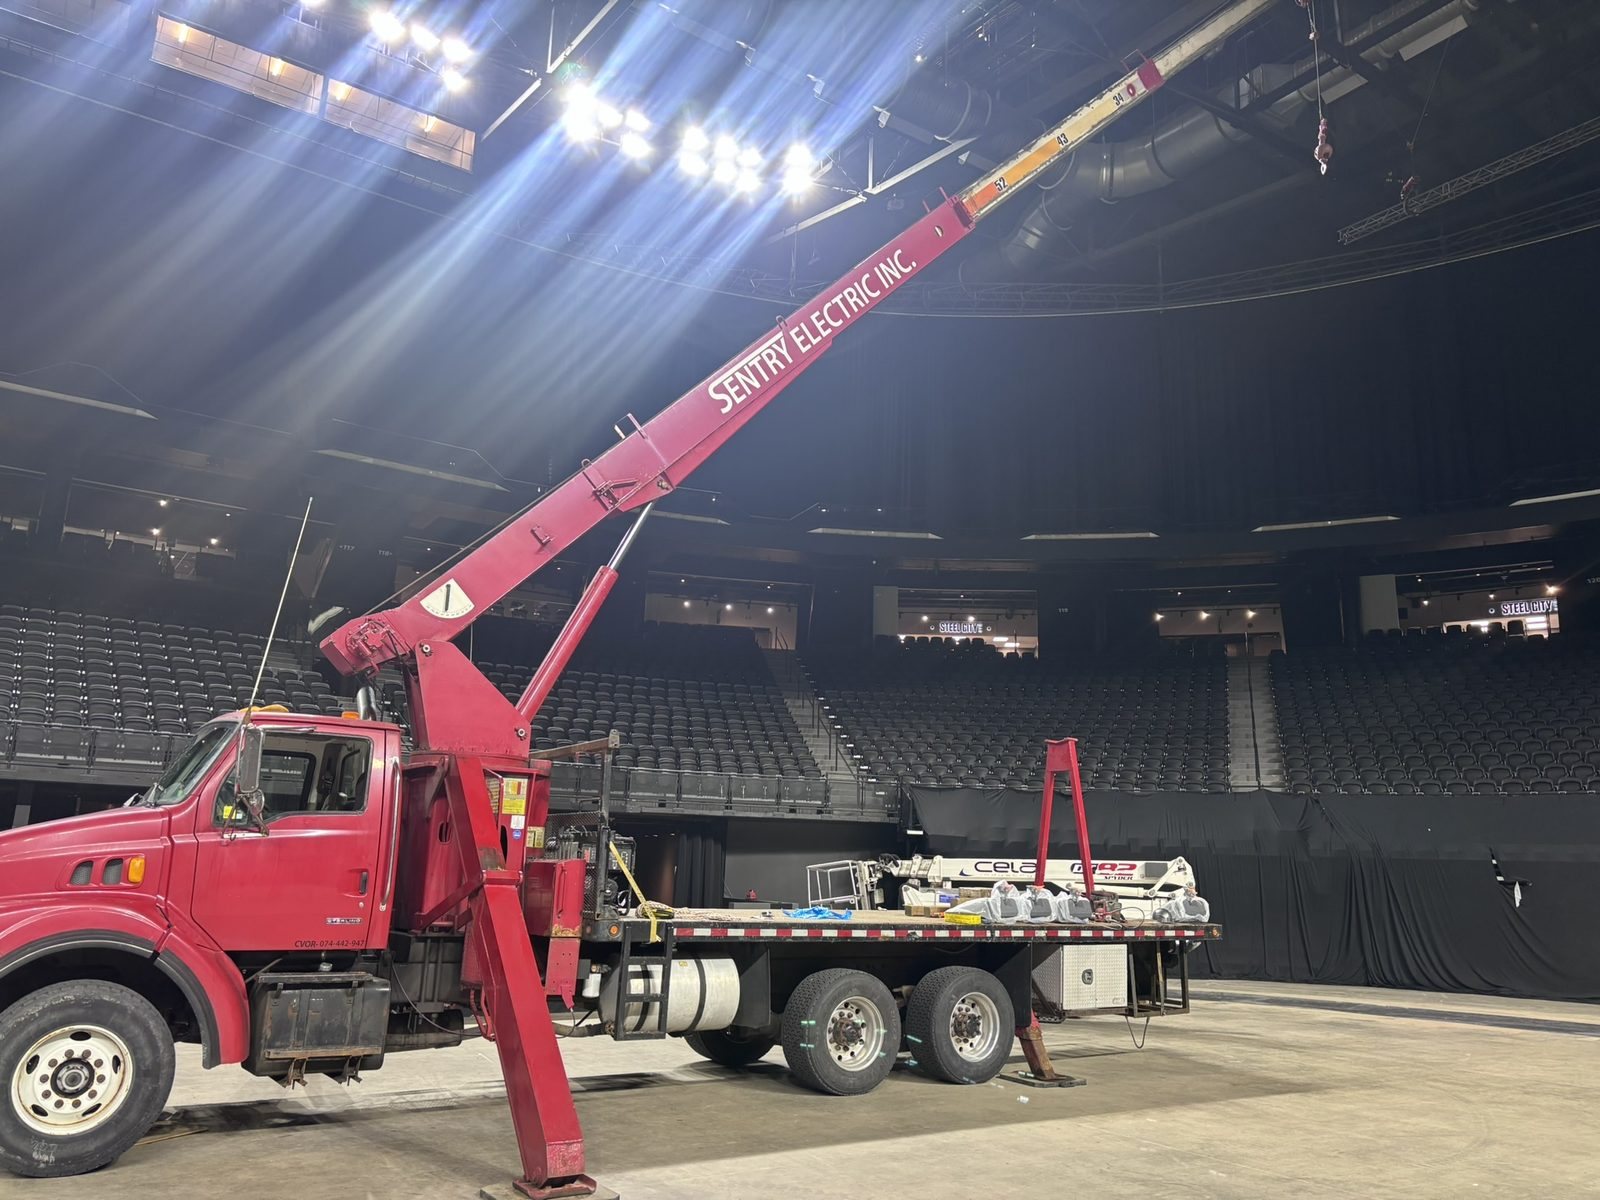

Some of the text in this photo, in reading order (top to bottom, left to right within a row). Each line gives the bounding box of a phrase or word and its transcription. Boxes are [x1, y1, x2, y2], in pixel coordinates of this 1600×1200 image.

[1113, 93, 1125, 106] 34
[1056, 133, 1069, 146] 43
[994, 177, 1008, 192] 52
[708, 249, 917, 414] SENTRY ELECTRIC INC.
[1501, 601, 1531, 615] STEEL
[1531, 600, 1553, 614] CITY
[939, 622, 961, 633] STEEL
